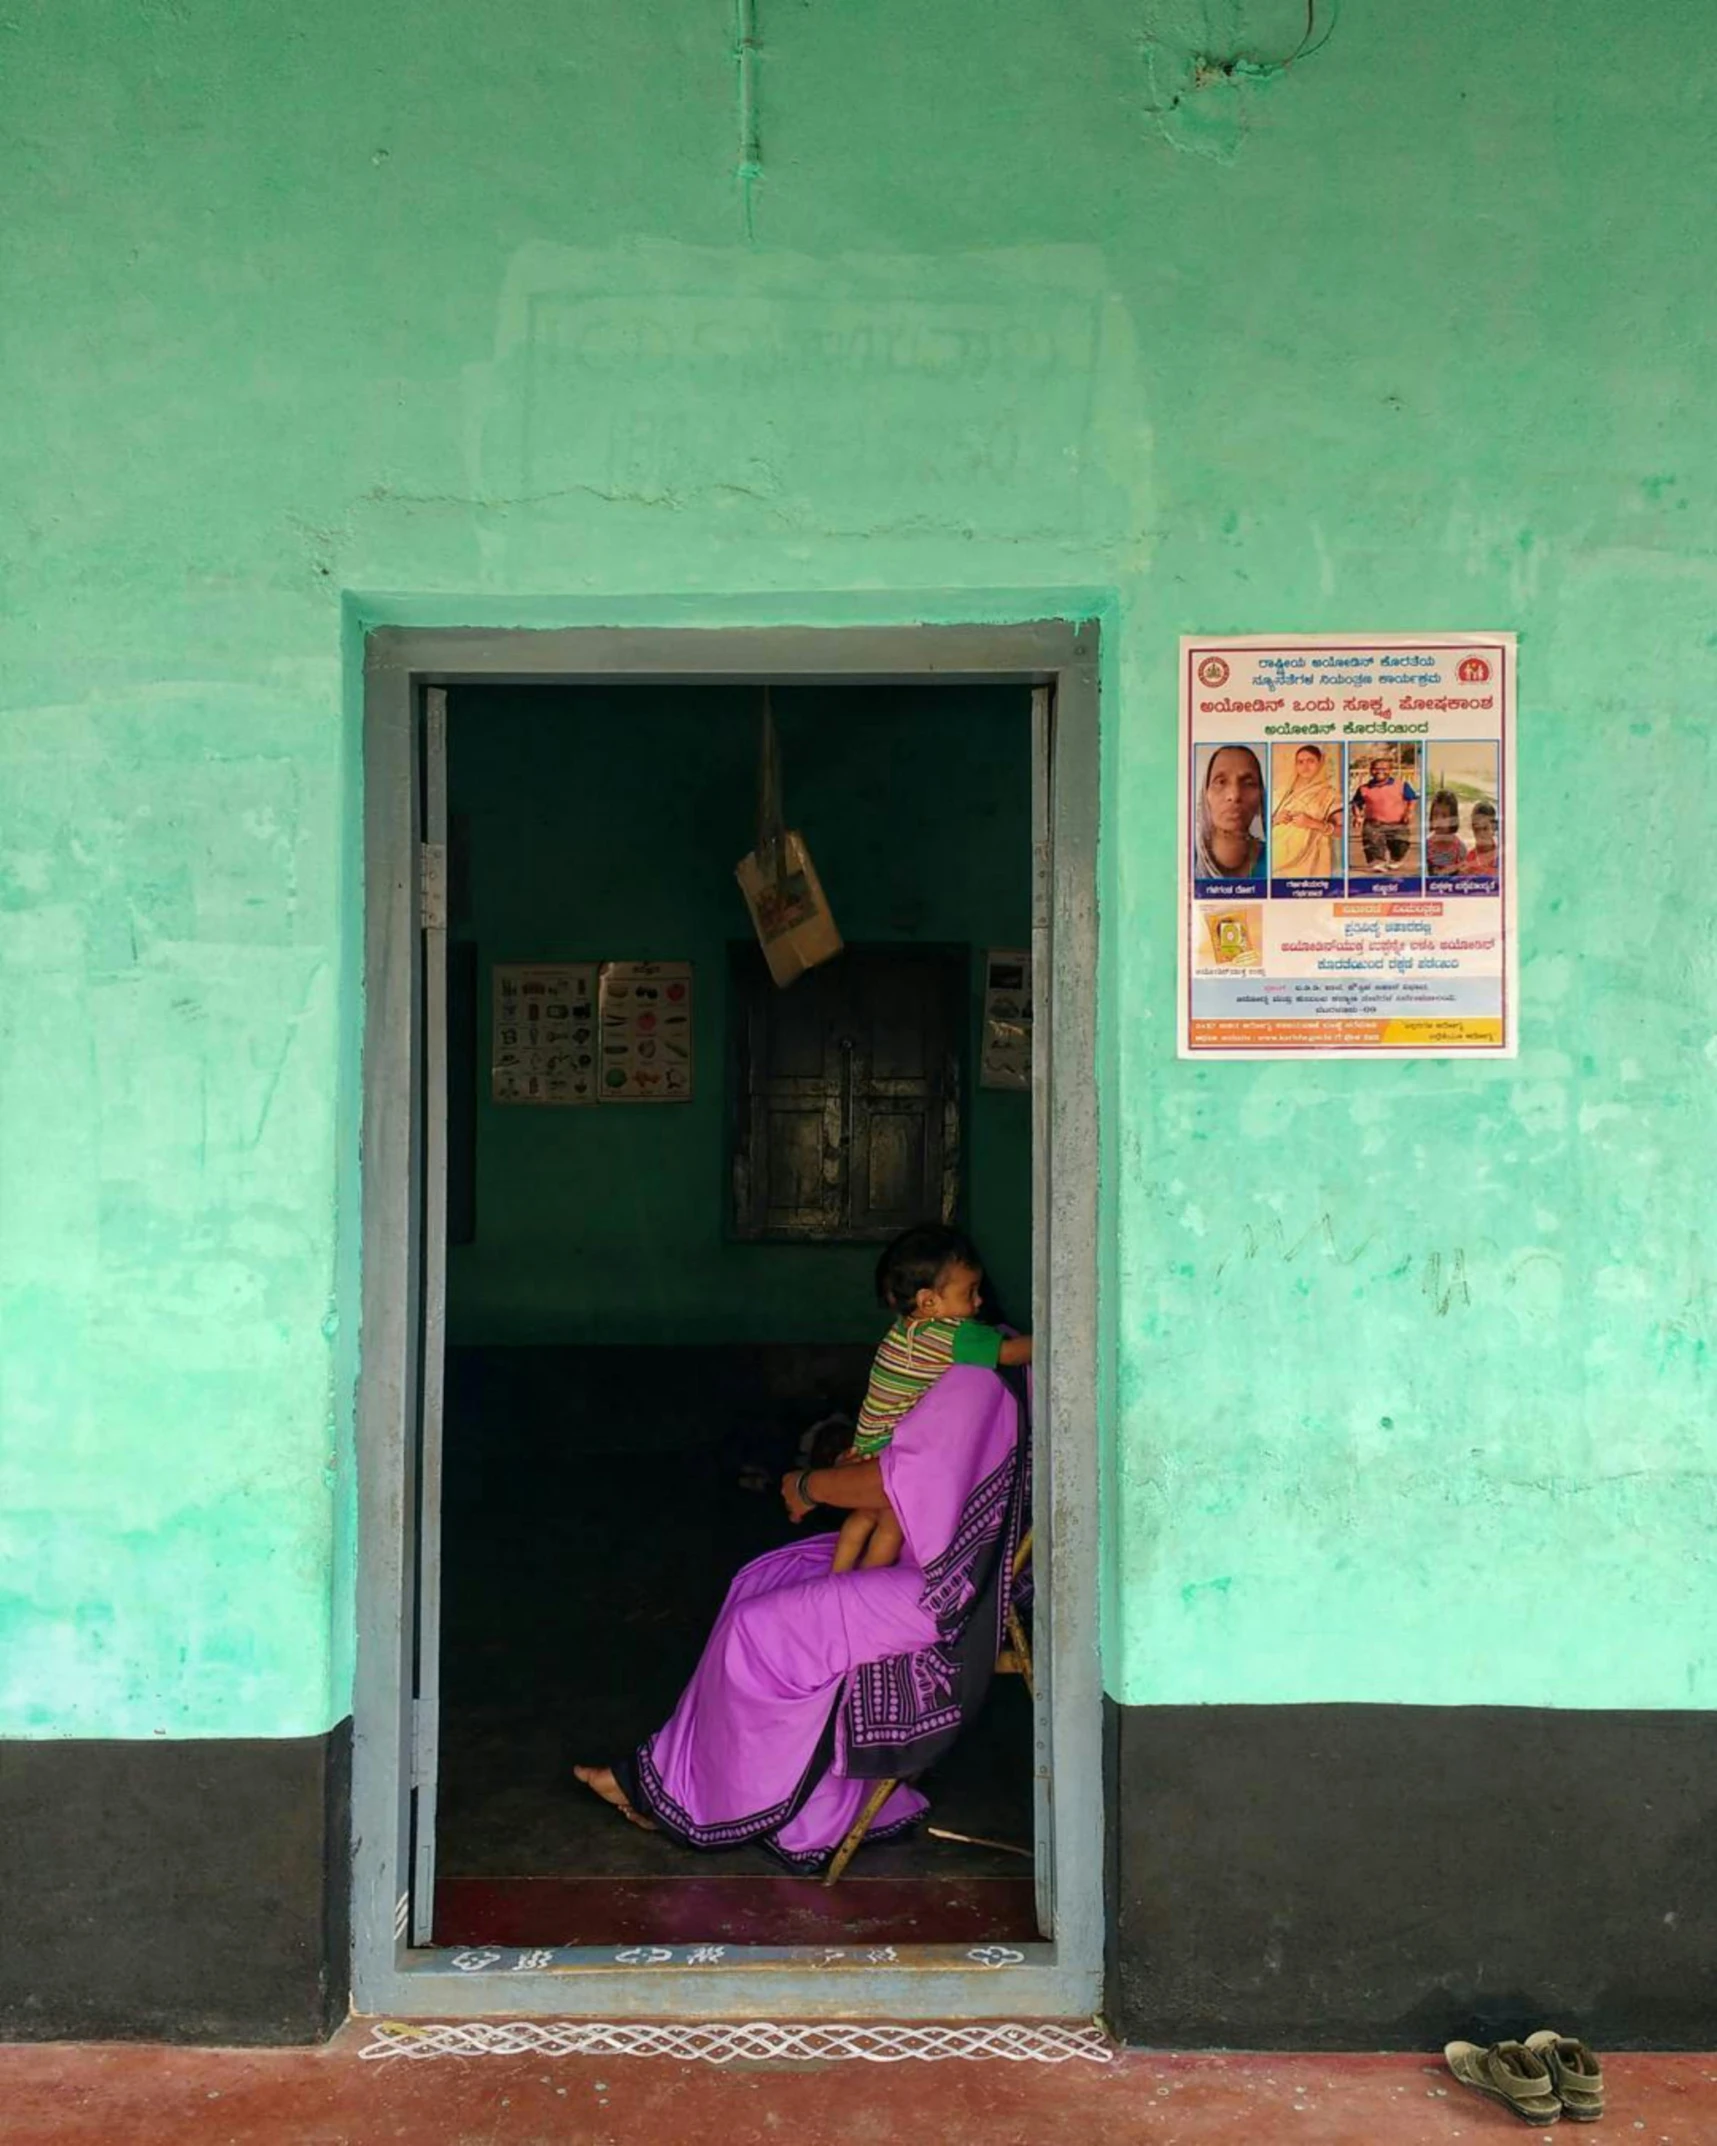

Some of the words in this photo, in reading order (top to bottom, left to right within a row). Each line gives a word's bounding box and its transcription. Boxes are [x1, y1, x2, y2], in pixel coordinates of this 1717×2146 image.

[1311, 656, 1373, 669] ಅಯೋಡಿನ್
[1200, 697, 1284, 712] ಅಯೋಡಿನ್
[1293, 697, 1334, 712] ಒಂದು
[1343, 696, 1392, 719] ಸೂಕ್ಷ್ಮ
[1399, 695, 1493, 711] ಪೋಷಕಾಂಶ
[1264, 722, 1336, 736] ಅಯೋಡಿನ್
[1343, 721, 1428, 735] ಕೊರತೆಯಿಂದ
